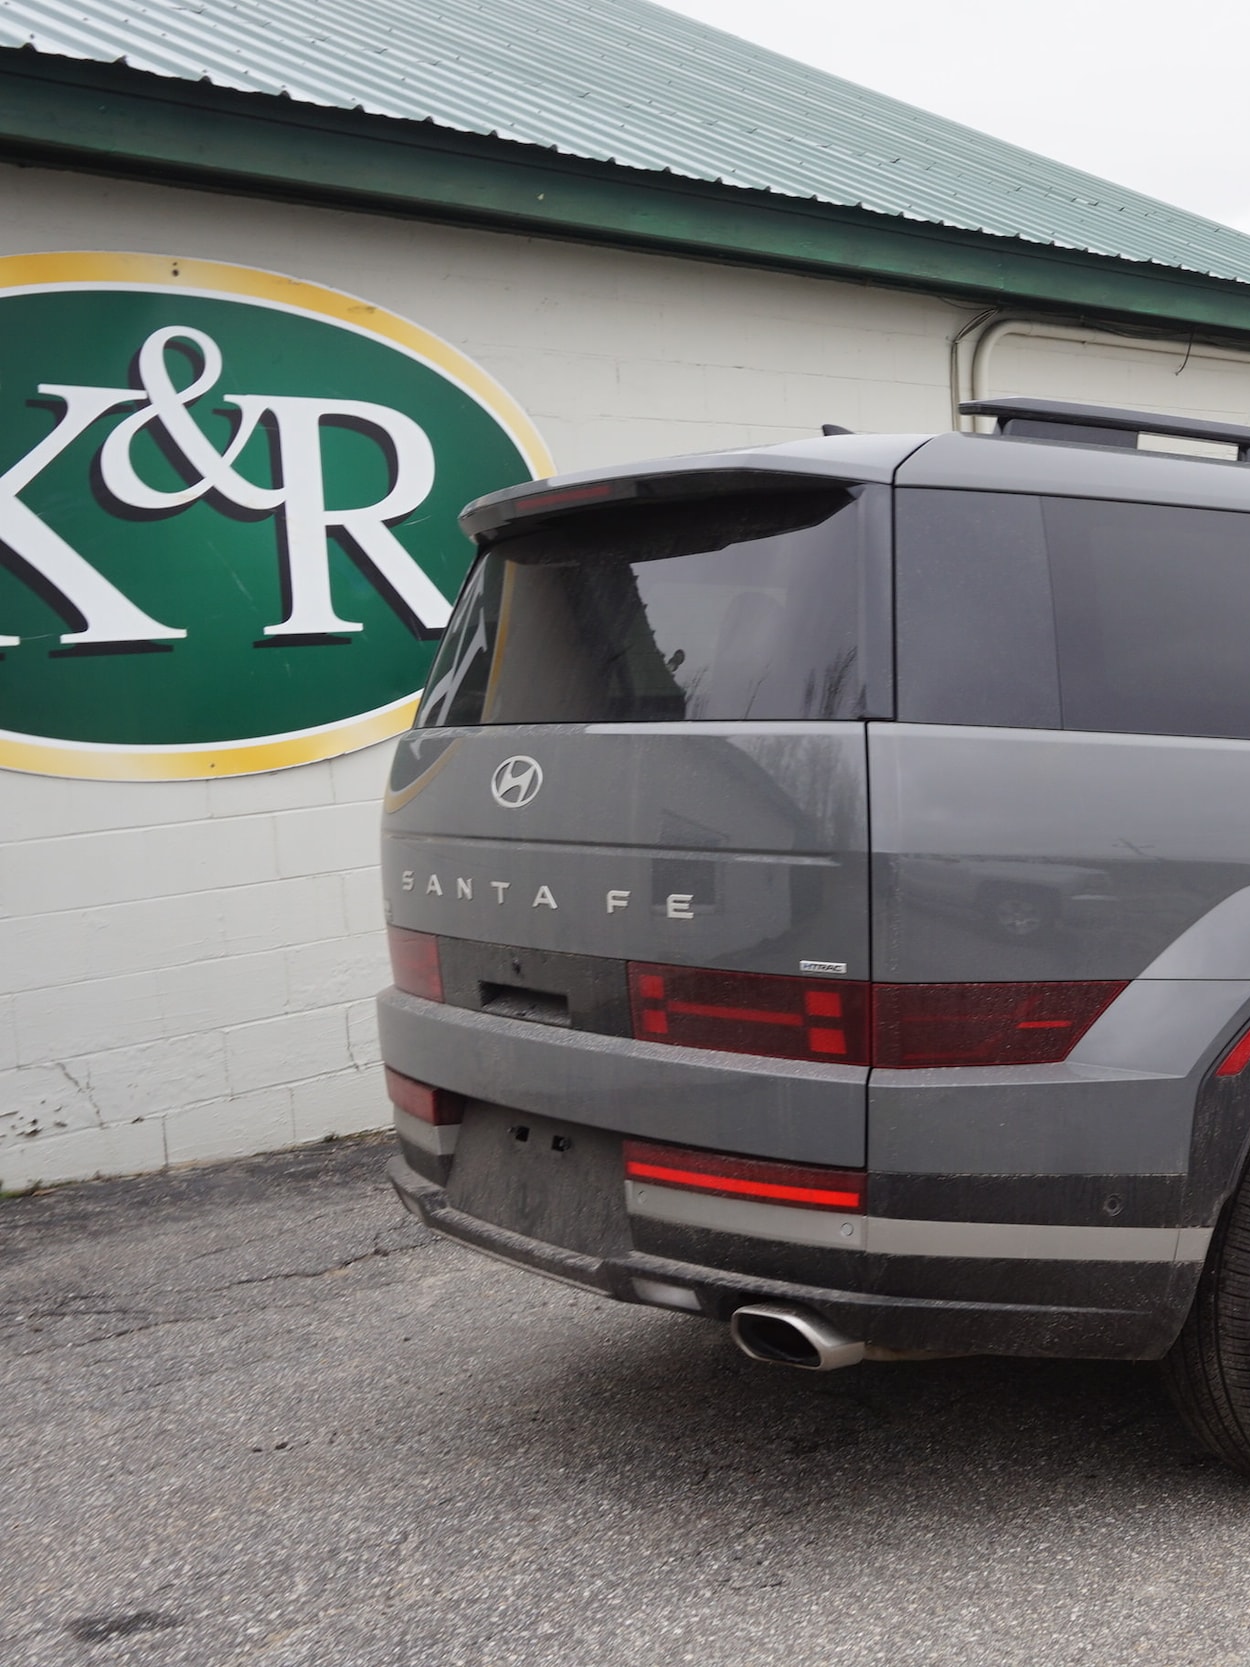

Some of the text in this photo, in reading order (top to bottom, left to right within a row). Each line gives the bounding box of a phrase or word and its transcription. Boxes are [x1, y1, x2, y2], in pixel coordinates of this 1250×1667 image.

[0, 325, 454, 646] K&R
[402, 870, 695, 920] SANTA FE
